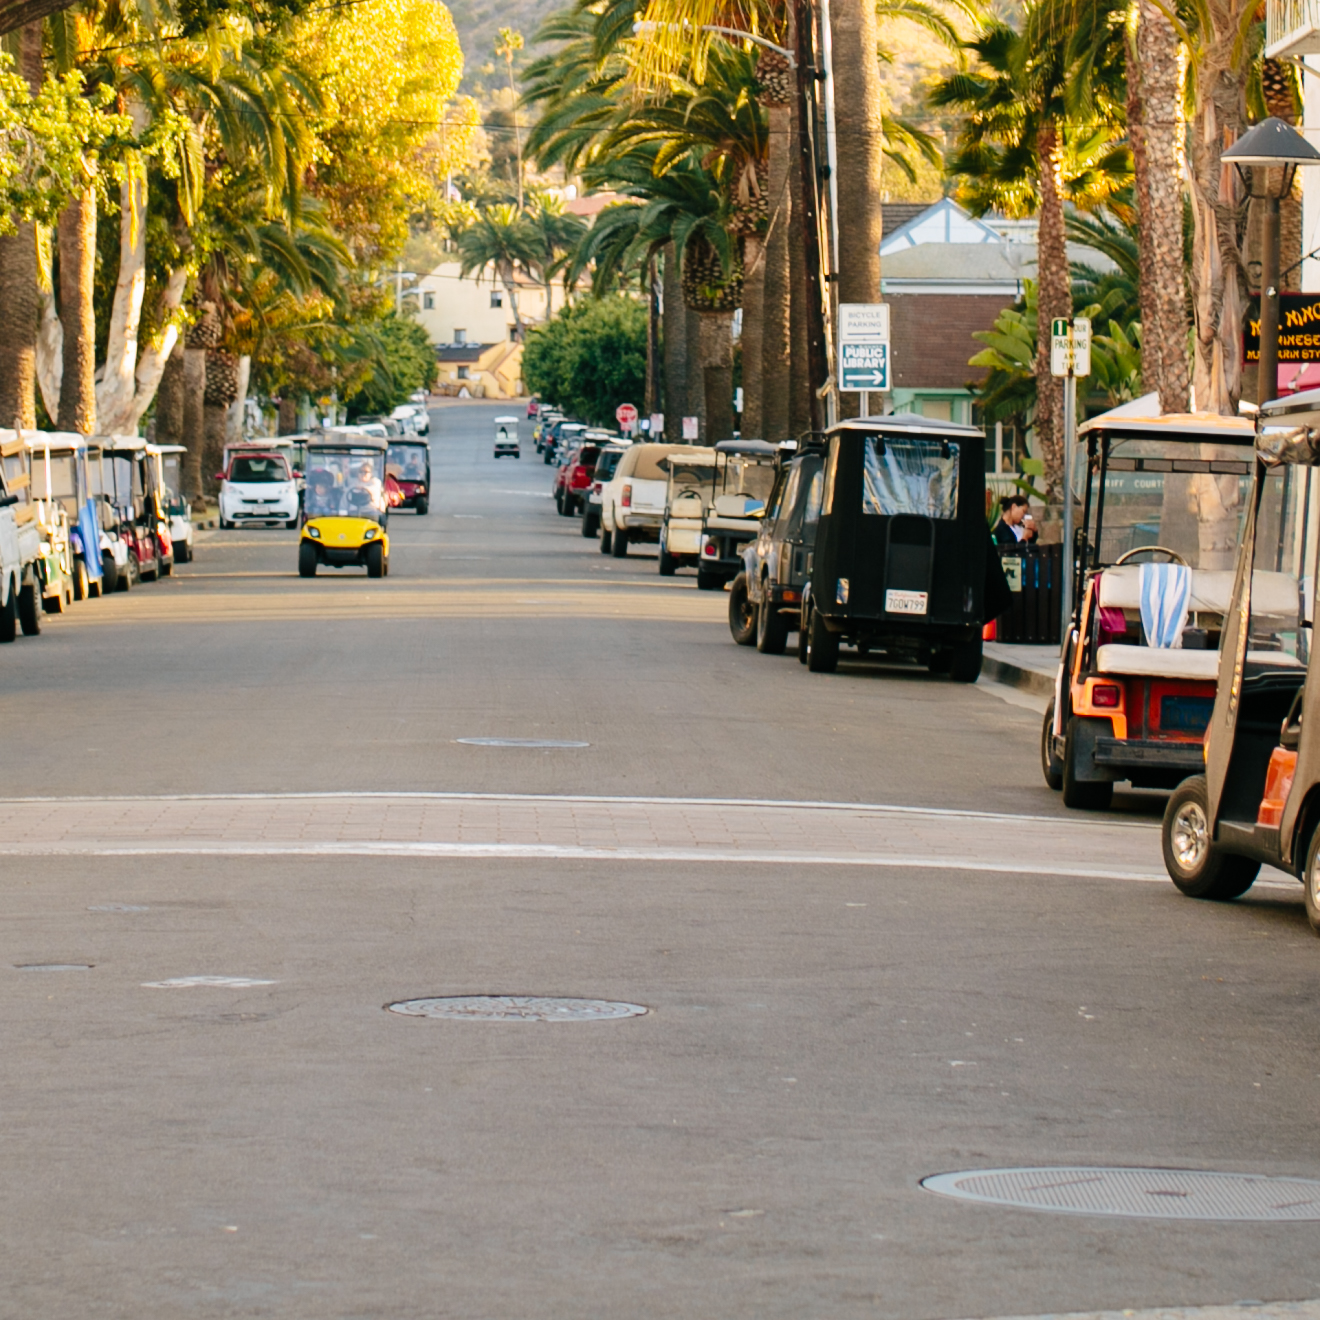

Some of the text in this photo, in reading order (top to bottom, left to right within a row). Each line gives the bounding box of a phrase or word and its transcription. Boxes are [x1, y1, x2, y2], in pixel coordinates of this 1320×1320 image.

[1057, 320, 1063, 336] 1
[1249, 318, 1283, 337] M.
[1054, 339, 1088, 350] PARKING
[845, 348, 884, 358] PUBLIC
[1246, 349, 1300, 360] MAARIN
[843, 358, 886, 369] LIBRARY
[1133, 479, 1165, 489] COURT
